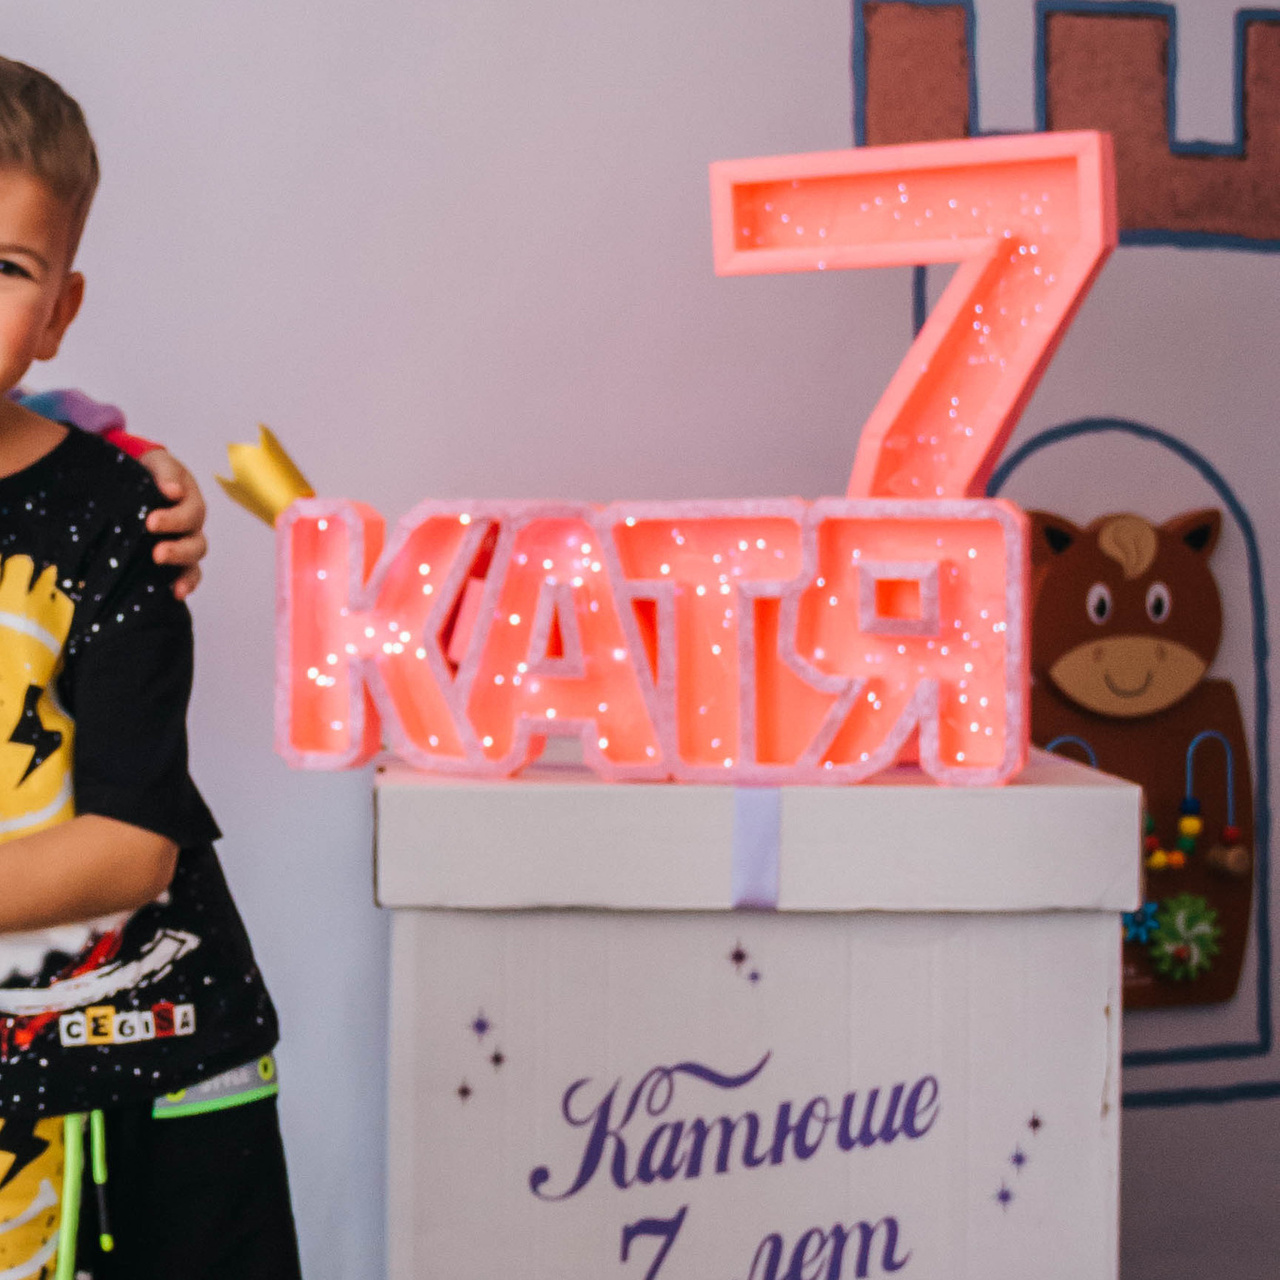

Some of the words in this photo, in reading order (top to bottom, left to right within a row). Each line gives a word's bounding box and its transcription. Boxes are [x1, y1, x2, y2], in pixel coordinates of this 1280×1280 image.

[710, 130, 1116, 499] 7
[275, 497, 1029, 786] КАТЯ
[529, 1050, 941, 1202] Катюше
